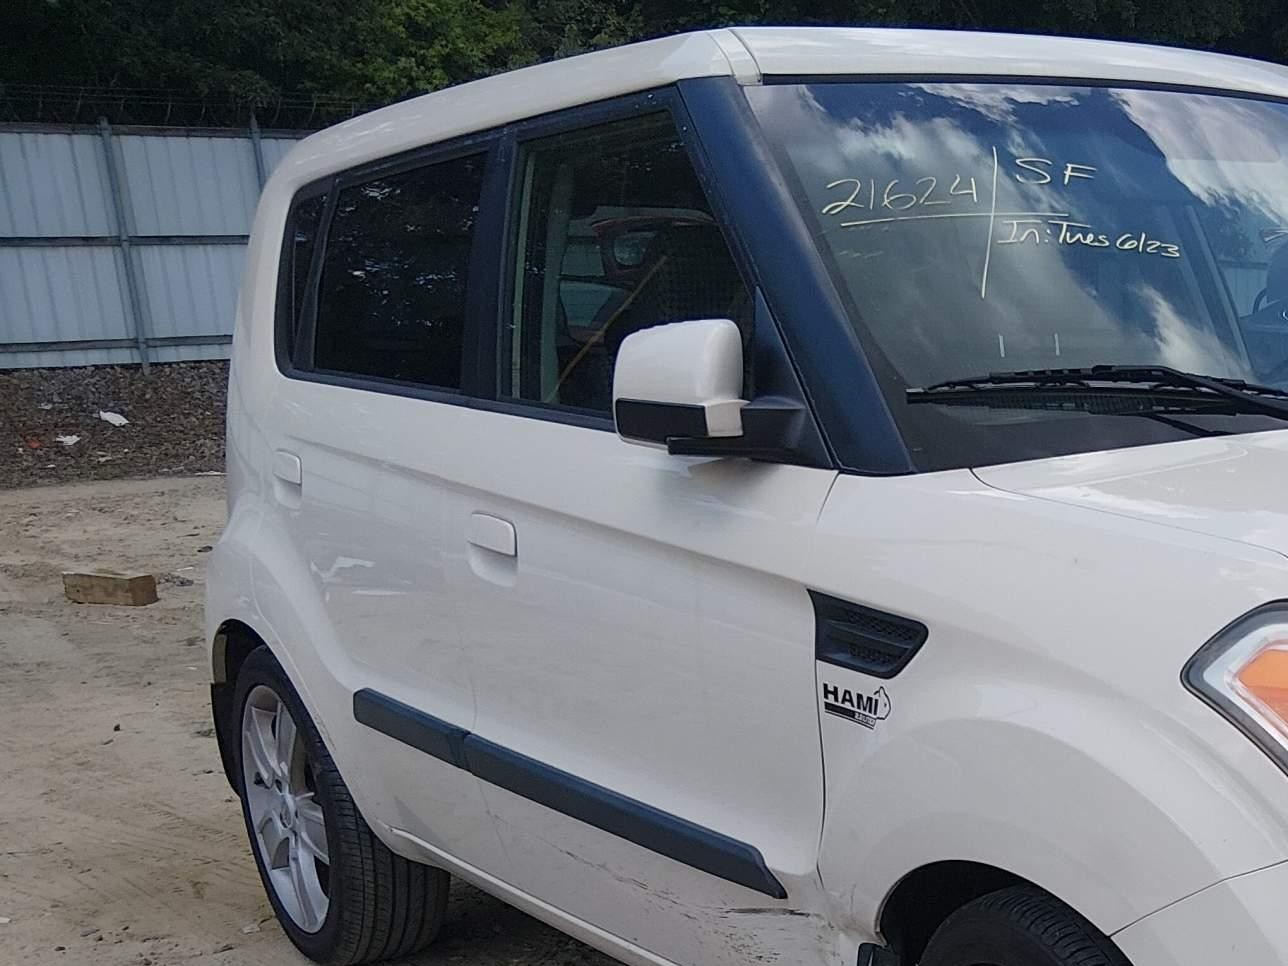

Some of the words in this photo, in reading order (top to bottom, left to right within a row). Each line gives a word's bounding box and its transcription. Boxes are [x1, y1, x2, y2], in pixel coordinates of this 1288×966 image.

[821, 174, 979, 216] 21624
[1048, 220, 1110, 247] Tues
[1116, 232, 1180, 258] 6/23
